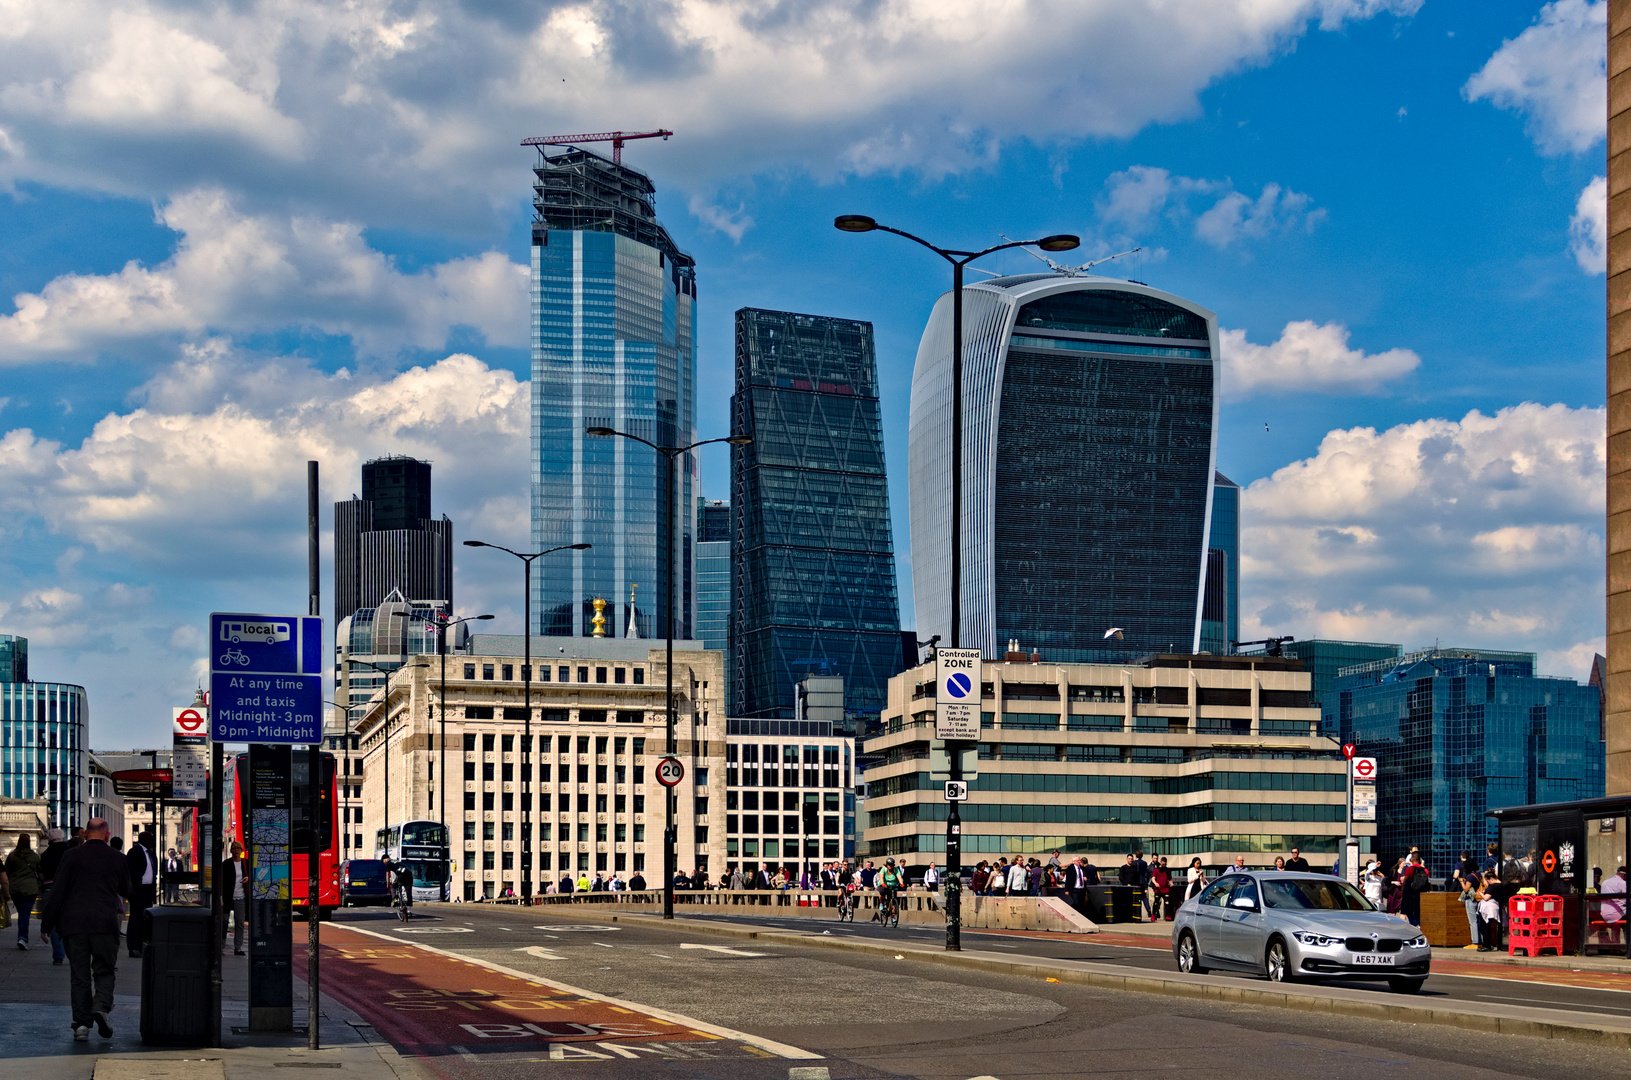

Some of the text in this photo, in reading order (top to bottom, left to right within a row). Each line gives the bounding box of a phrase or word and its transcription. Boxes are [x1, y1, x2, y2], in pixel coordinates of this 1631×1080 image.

[244, 623, 275, 634] local
[944, 660, 972, 668] ZONE
[230, 678, 304, 691] At any time
[237, 696, 296, 707] and taxis
[220, 710, 276, 724] Midnight
[258, 726, 314, 739] Midnight
[1346, 746, 1353, 756] Y
[662, 766, 680, 777] 20
[1356, 956, 1376, 964] AE67
[458, 1022, 664, 1038] BUS
